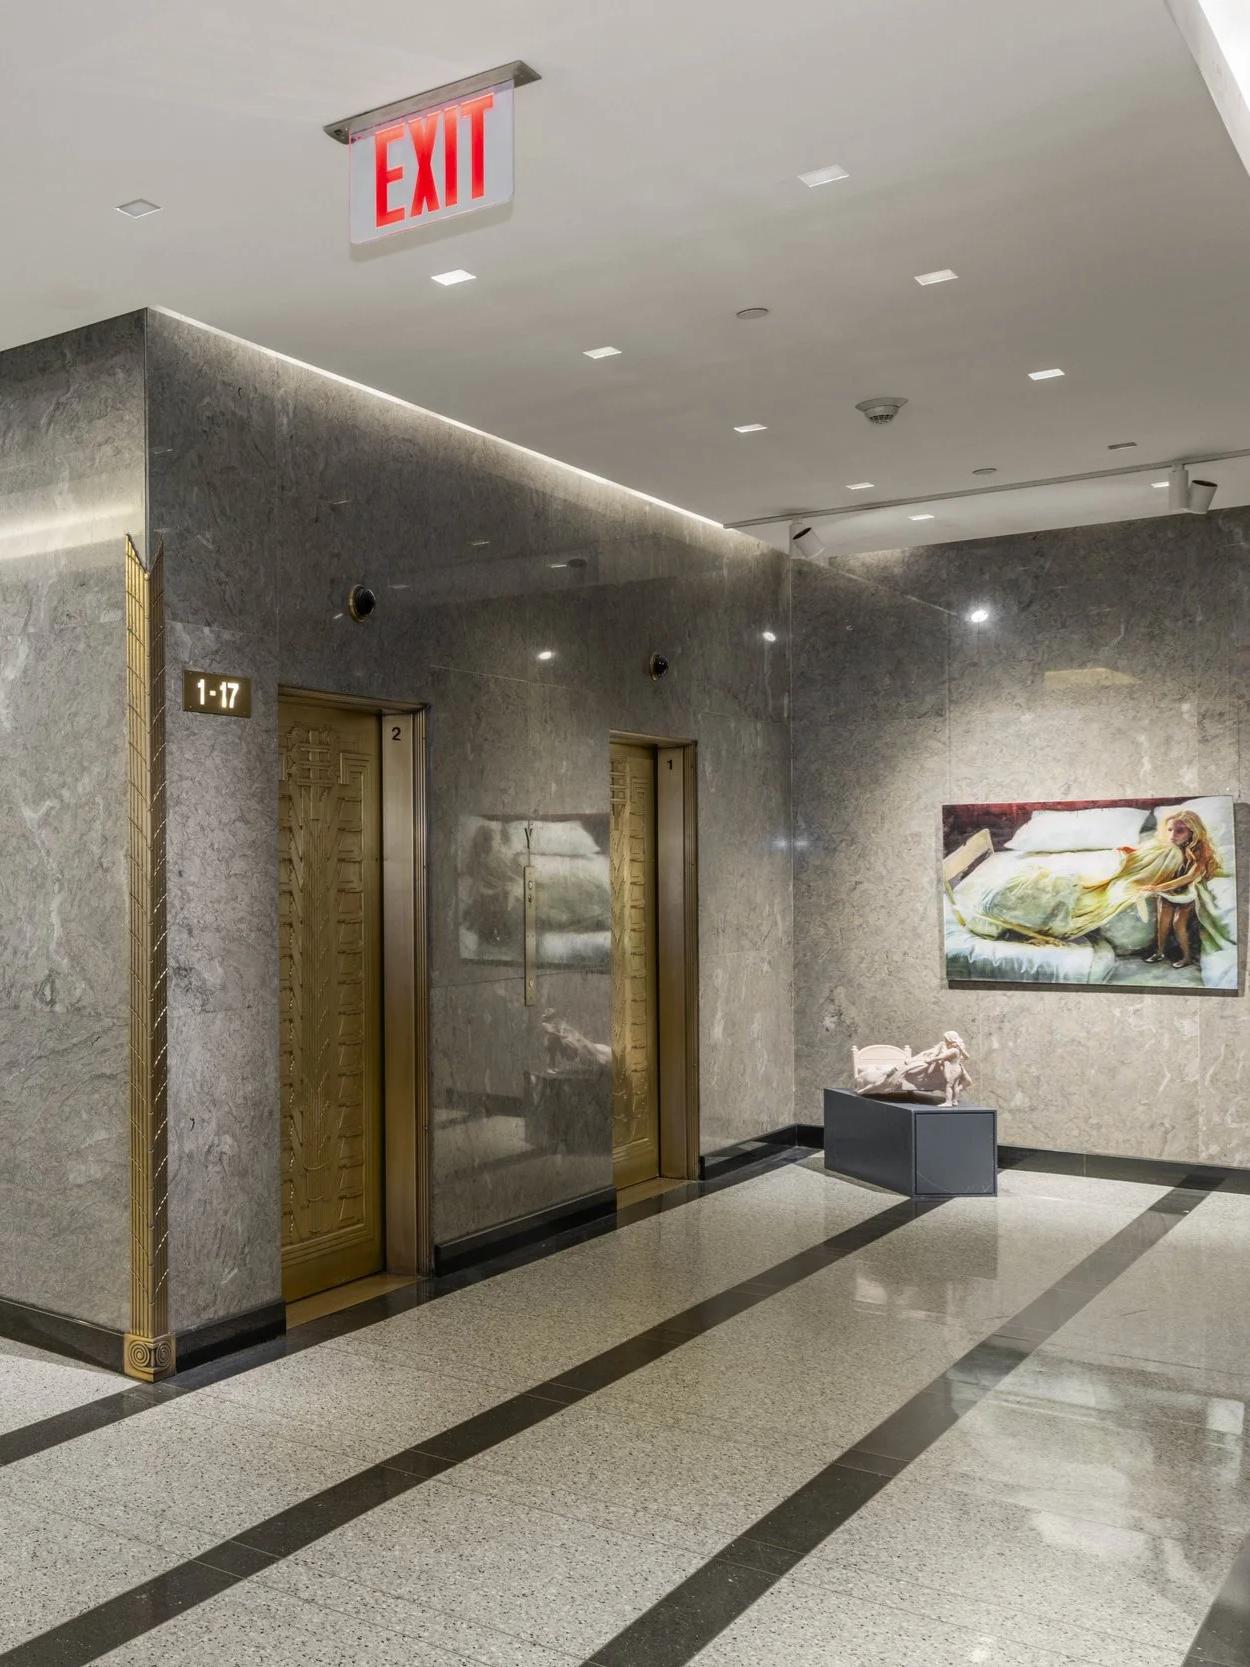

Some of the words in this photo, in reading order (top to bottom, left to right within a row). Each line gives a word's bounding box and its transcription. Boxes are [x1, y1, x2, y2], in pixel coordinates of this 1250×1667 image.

[374, 92, 495, 230] EXIT
[197, 678, 239, 709] 1-17
[391, 726, 402, 742] 2
[666, 759, 673, 770] 1
